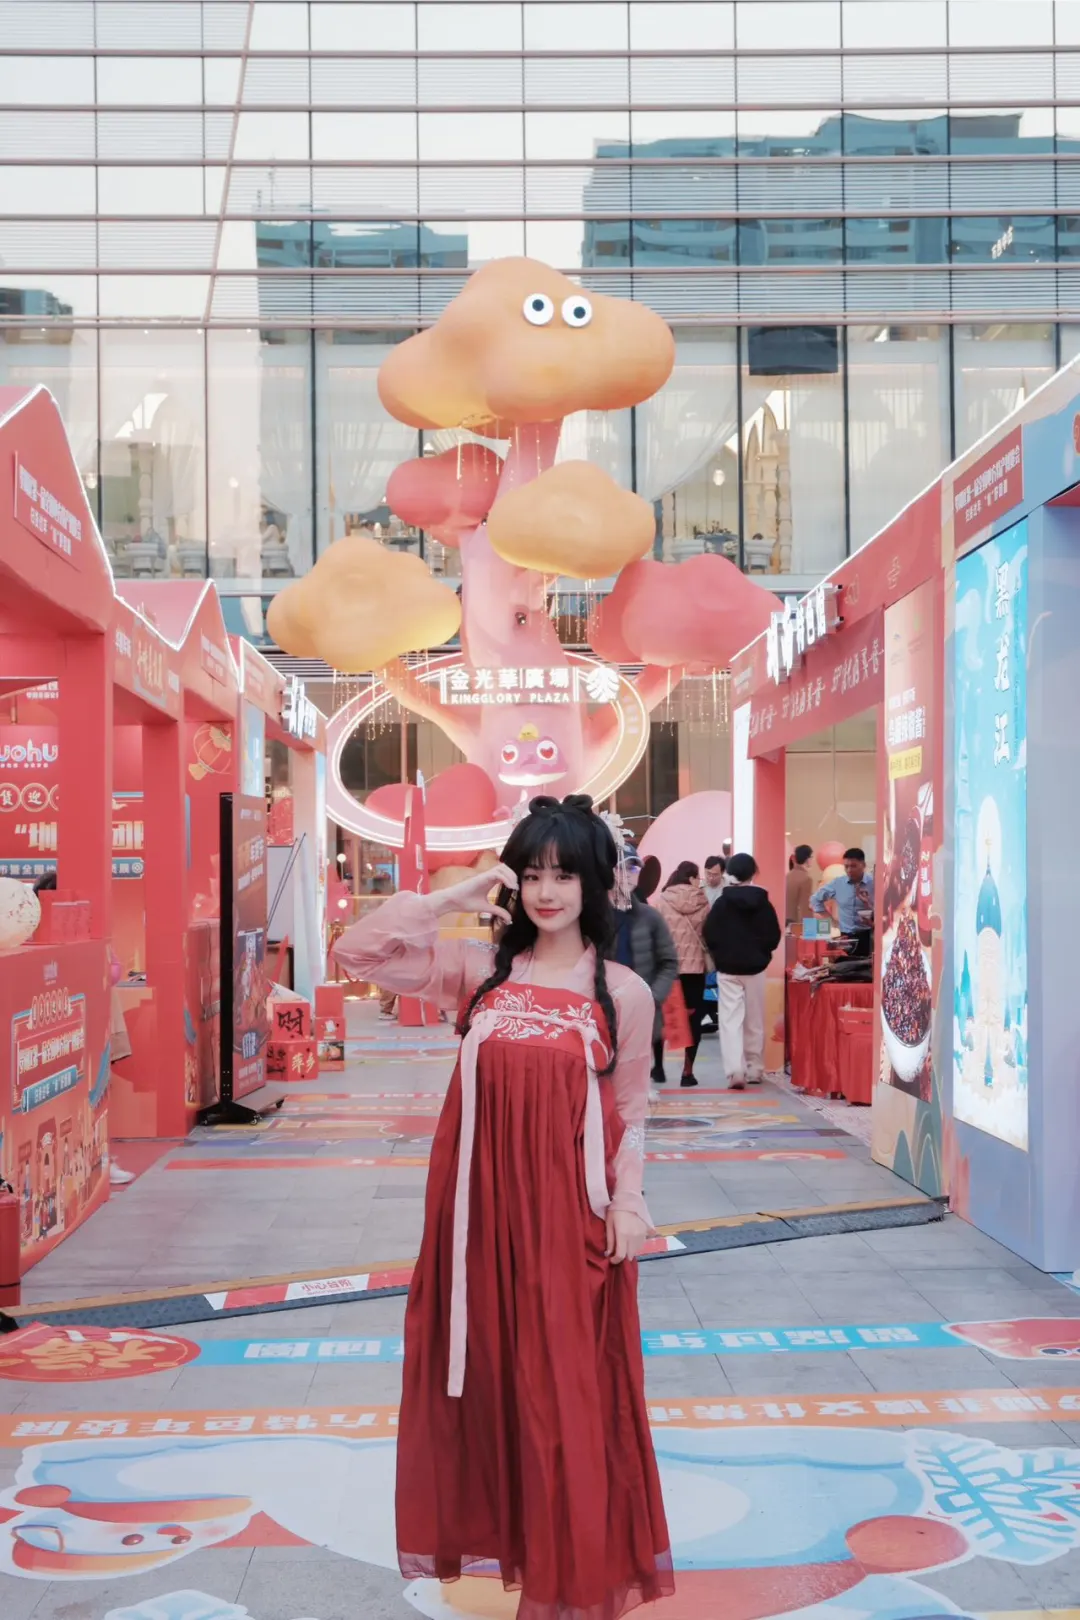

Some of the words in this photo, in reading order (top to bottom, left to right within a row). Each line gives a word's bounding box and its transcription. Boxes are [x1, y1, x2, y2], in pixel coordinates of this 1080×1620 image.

[451, 693, 521, 704] KINGGLORY
[530, 693, 570, 703] PLAZA
[291, 1051, 316, 1073] 萍乡
[301, 1279, 352, 1292] 小心台阶
[11, 1412, 398, 1438] 方特色年货展
